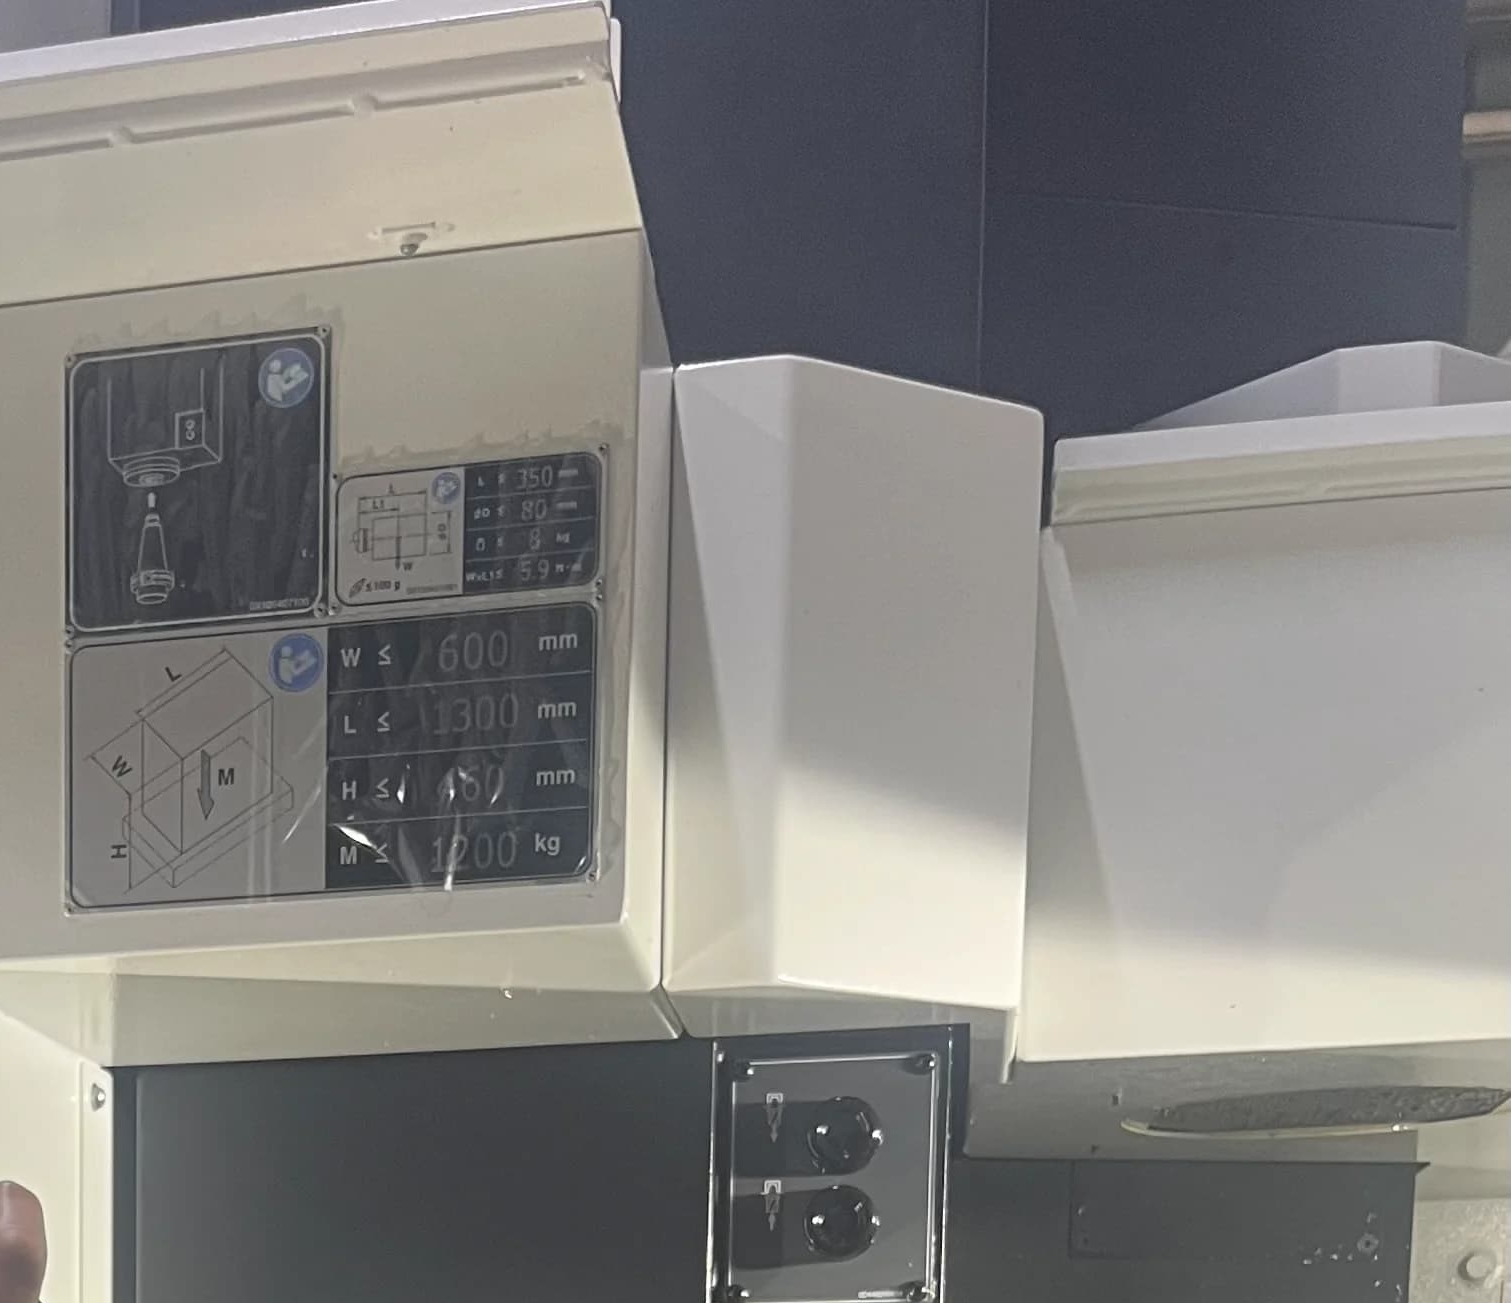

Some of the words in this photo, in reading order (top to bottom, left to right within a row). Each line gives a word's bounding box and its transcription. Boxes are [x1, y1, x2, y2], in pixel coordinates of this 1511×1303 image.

[341, 648, 361, 668] W
[439, 630, 508, 671] 600
[539, 632, 579, 651] mm
[164, 666, 182, 683] L
[343, 715, 357, 735] L
[432, 692, 519, 736] 1300
[537, 701, 577, 720] mm
[112, 755, 133, 779] W
[218, 768, 235, 787] M
[342, 780, 357, 800] H
[536, 768, 576, 786] mm
[110, 844, 127, 860] H
[340, 846, 358, 865] M
[430, 830, 518, 873] 1200
[534, 834, 561, 855] kg
